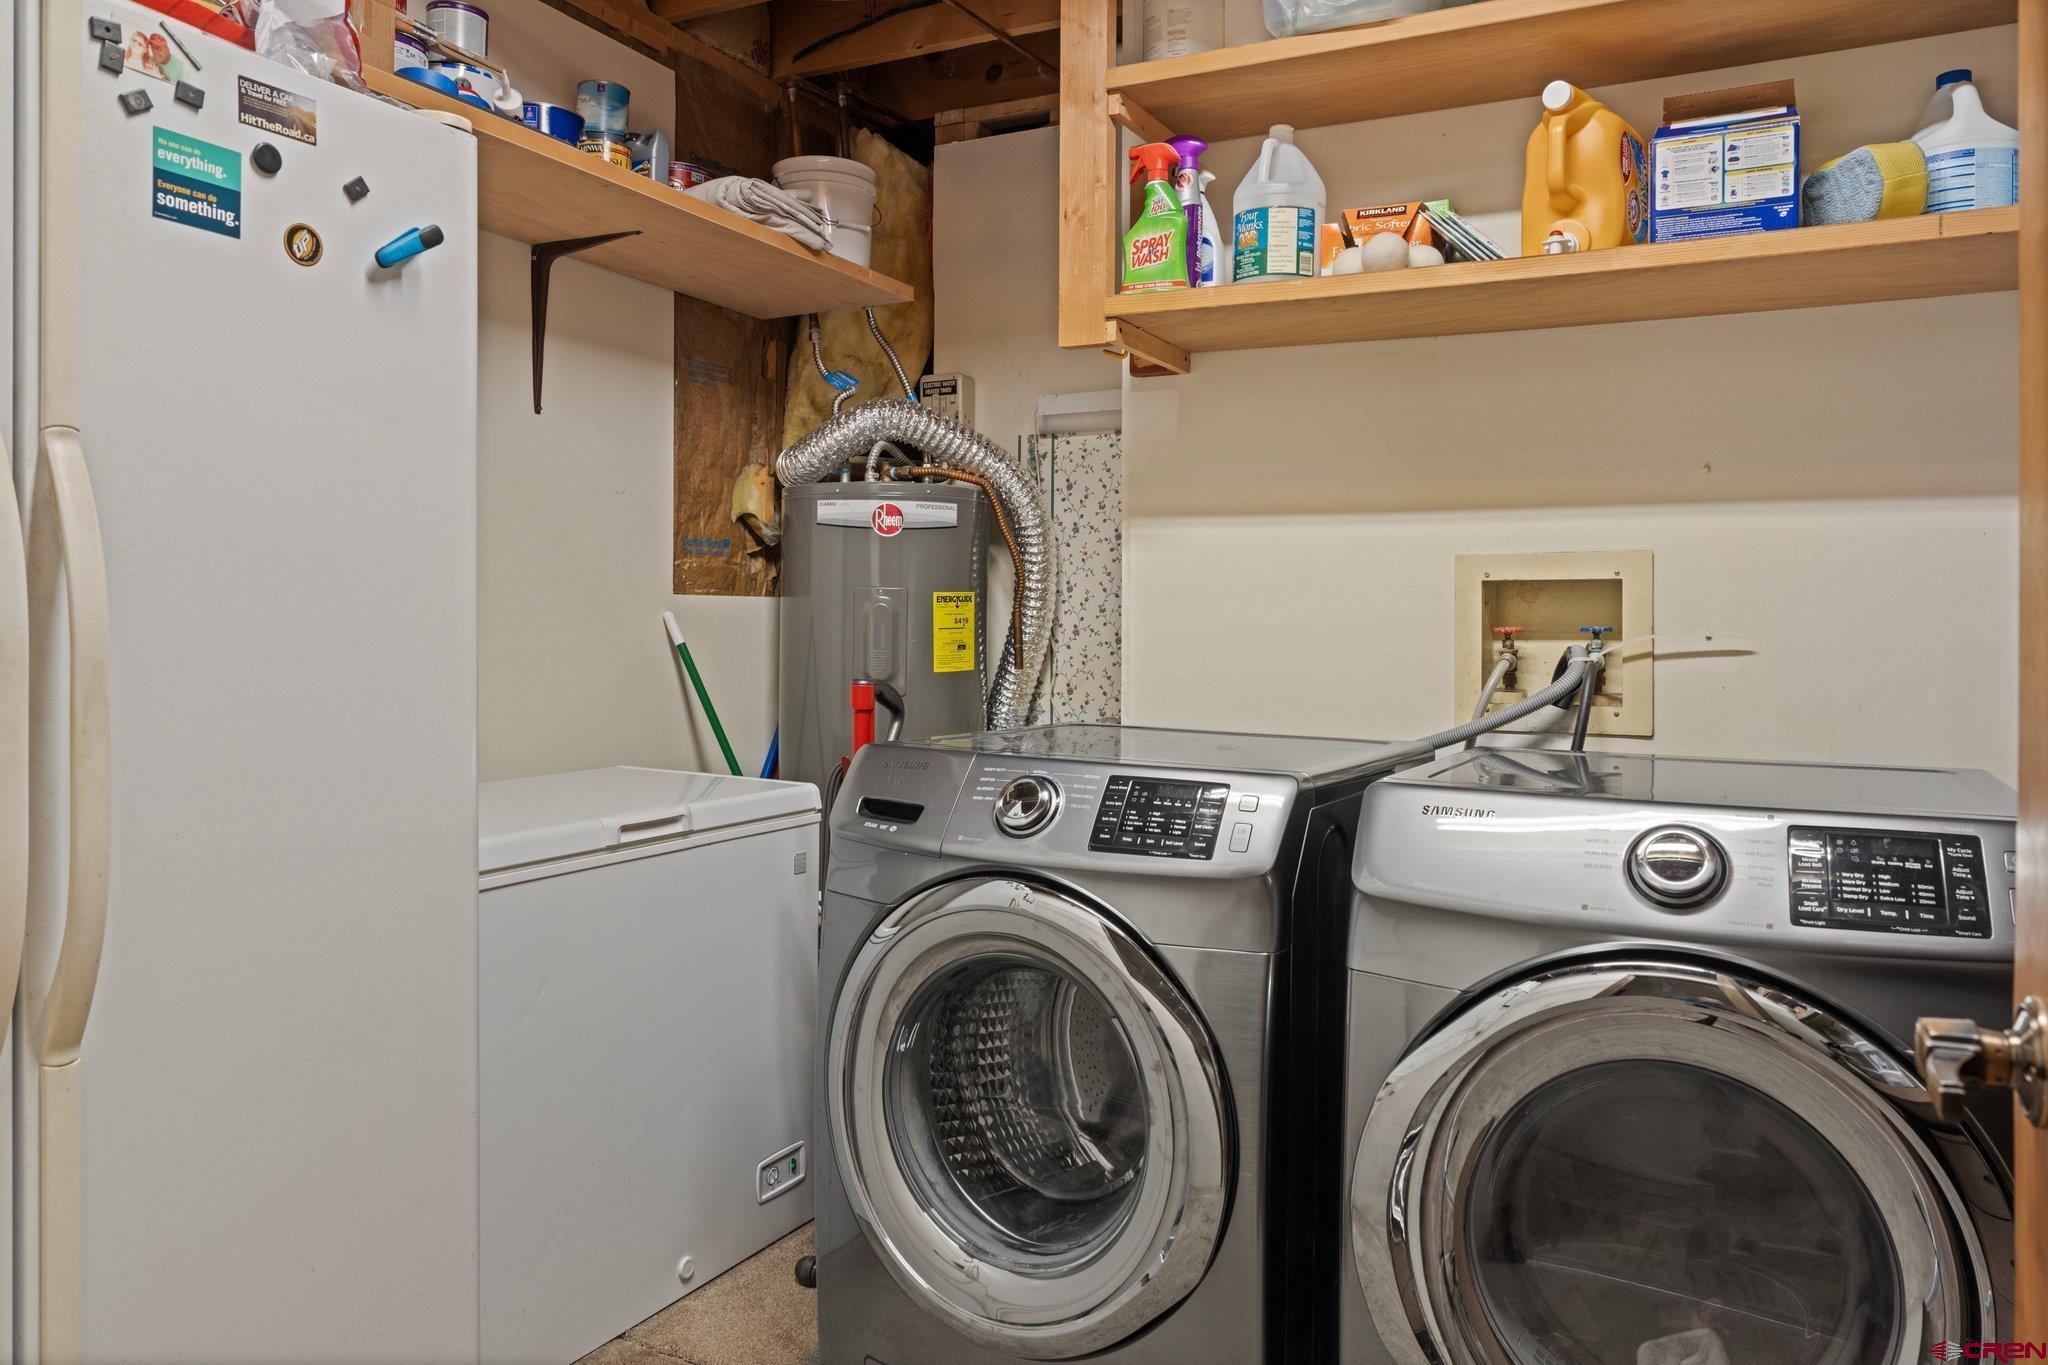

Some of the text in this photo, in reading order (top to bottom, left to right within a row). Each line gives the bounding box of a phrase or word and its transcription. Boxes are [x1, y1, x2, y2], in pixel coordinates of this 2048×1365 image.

[240, 79, 294, 103] DELIVER A CAR
[240, 112, 315, 143] HitTheRoad.ca
[158, 137, 167, 146] No
[181, 145, 192, 153] can
[157, 148, 227, 179] everything.
[157, 179, 218, 203] Everyone can do
[157, 192, 239, 227] something.
[1240, 211, 1259, 222] Four
[1359, 206, 1406, 216] KIRKLAND
[1236, 221, 1263, 236] Monks
[1132, 230, 1173, 256] SPRAY
[1132, 247, 1170, 269] WASH
[875, 503, 903, 531] Rheem
[884, 760, 930, 770] SAMSUNG
[1422, 805, 1496, 818] SAMSUNG
